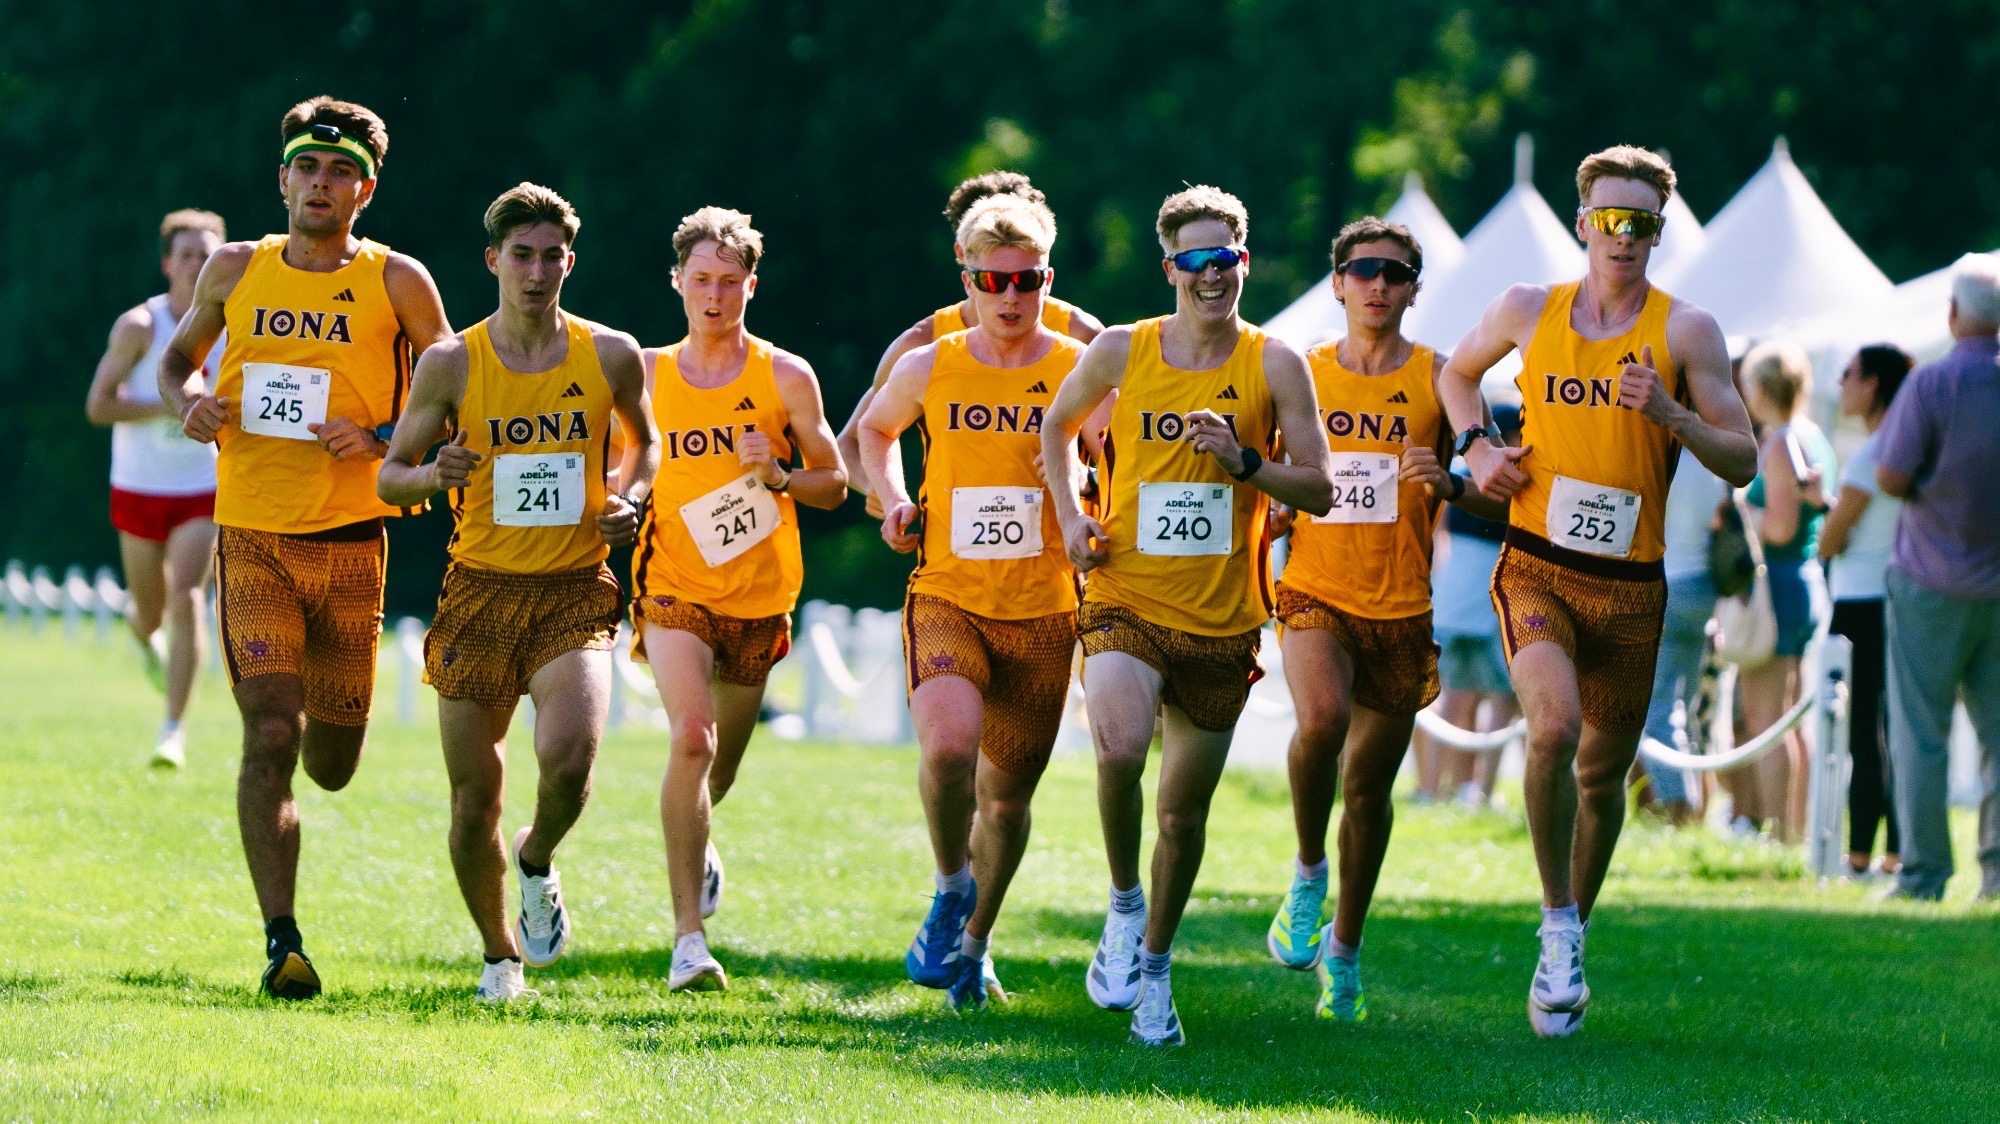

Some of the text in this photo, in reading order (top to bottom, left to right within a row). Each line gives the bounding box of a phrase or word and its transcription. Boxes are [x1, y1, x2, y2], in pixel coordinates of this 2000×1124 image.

[251, 308, 354, 344] IONA
[266, 380, 301, 391] ADELPHI
[1544, 374, 1624, 408] ION
[258, 396, 303, 423] 245
[947, 402, 1046, 434] IONA
[485, 410, 591, 449] IONA
[1139, 411, 1240, 443] IO
[1319, 408, 1408, 443] ONA
[666, 423, 758, 460] ION
[519, 471, 558, 479] ADELPHI
[516, 487, 560, 511] 241
[711, 496, 744, 518] ADELPHI
[978, 505, 1016, 513] ADELPHI
[1165, 500, 1204, 508] ADELPHI
[1333, 485, 1376, 509] 248
[1578, 499, 1616, 512] ADELPHI
[715, 507, 757, 547] 247
[971, 521, 1024, 545] 250
[1156, 516, 1212, 541] 240
[1567, 513, 1616, 543] 252
